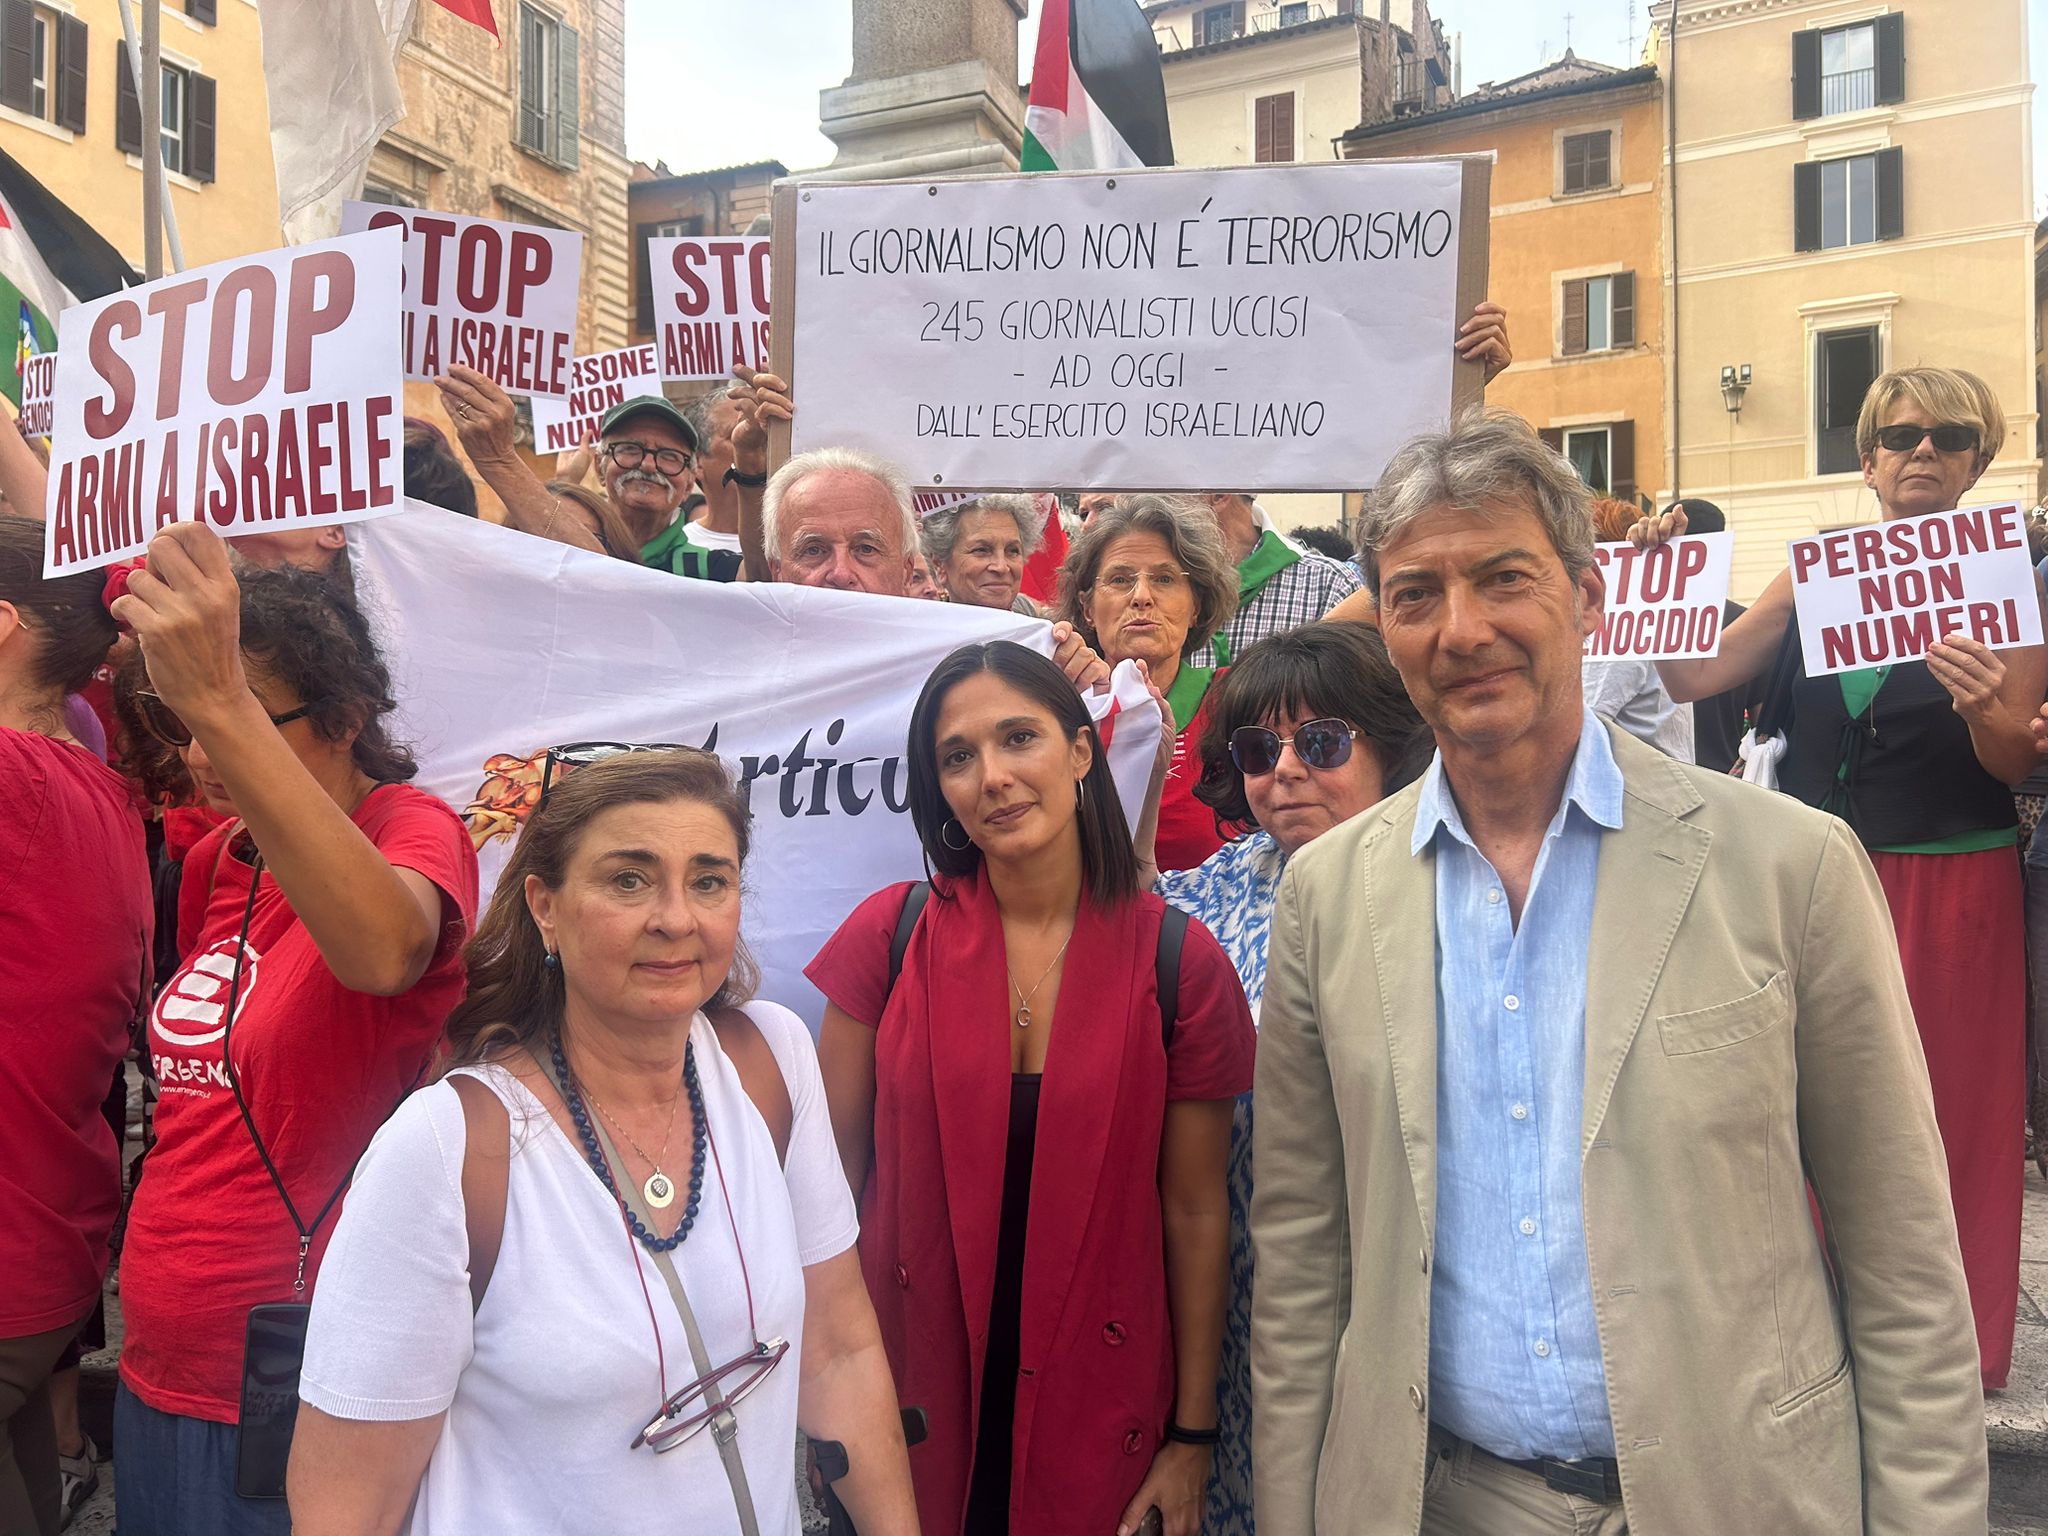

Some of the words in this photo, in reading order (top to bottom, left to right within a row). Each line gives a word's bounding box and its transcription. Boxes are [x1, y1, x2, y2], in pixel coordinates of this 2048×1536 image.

[849, 223, 1065, 274] GIORNALISMO
[1082, 222, 1156, 269] NON
[1218, 209, 1452, 265] TERRORISMO
[84, 250, 356, 440] STOP
[920, 300, 985, 342] 245
[1000, 297, 1194, 340] GIORNALISTI
[1212, 296, 1308, 338] UCCISI
[422, 314, 440, 376] A
[450, 317, 570, 395] ISRAELE
[665, 322, 724, 376] ARMI
[1050, 354, 1092, 389] AD
[1111, 352, 1184, 388] OGGI
[26, 355, 57, 400] STO
[569, 383, 624, 417] NON
[917, 405, 983, 438] DALL'
[993, 402, 1126, 439] ESERCITO
[1145, 401, 1325, 437] ISRAELIANO
[54, 438, 145, 567] ARMI
[156, 430, 178, 530] A
[194, 396, 394, 527] ISRAELE
[1792, 505, 2022, 584] PERSONE
[1858, 562, 1965, 615] NON
[1582, 605, 1719, 656] NOCIDIO
[1821, 599, 2020, 669] NUMERI
